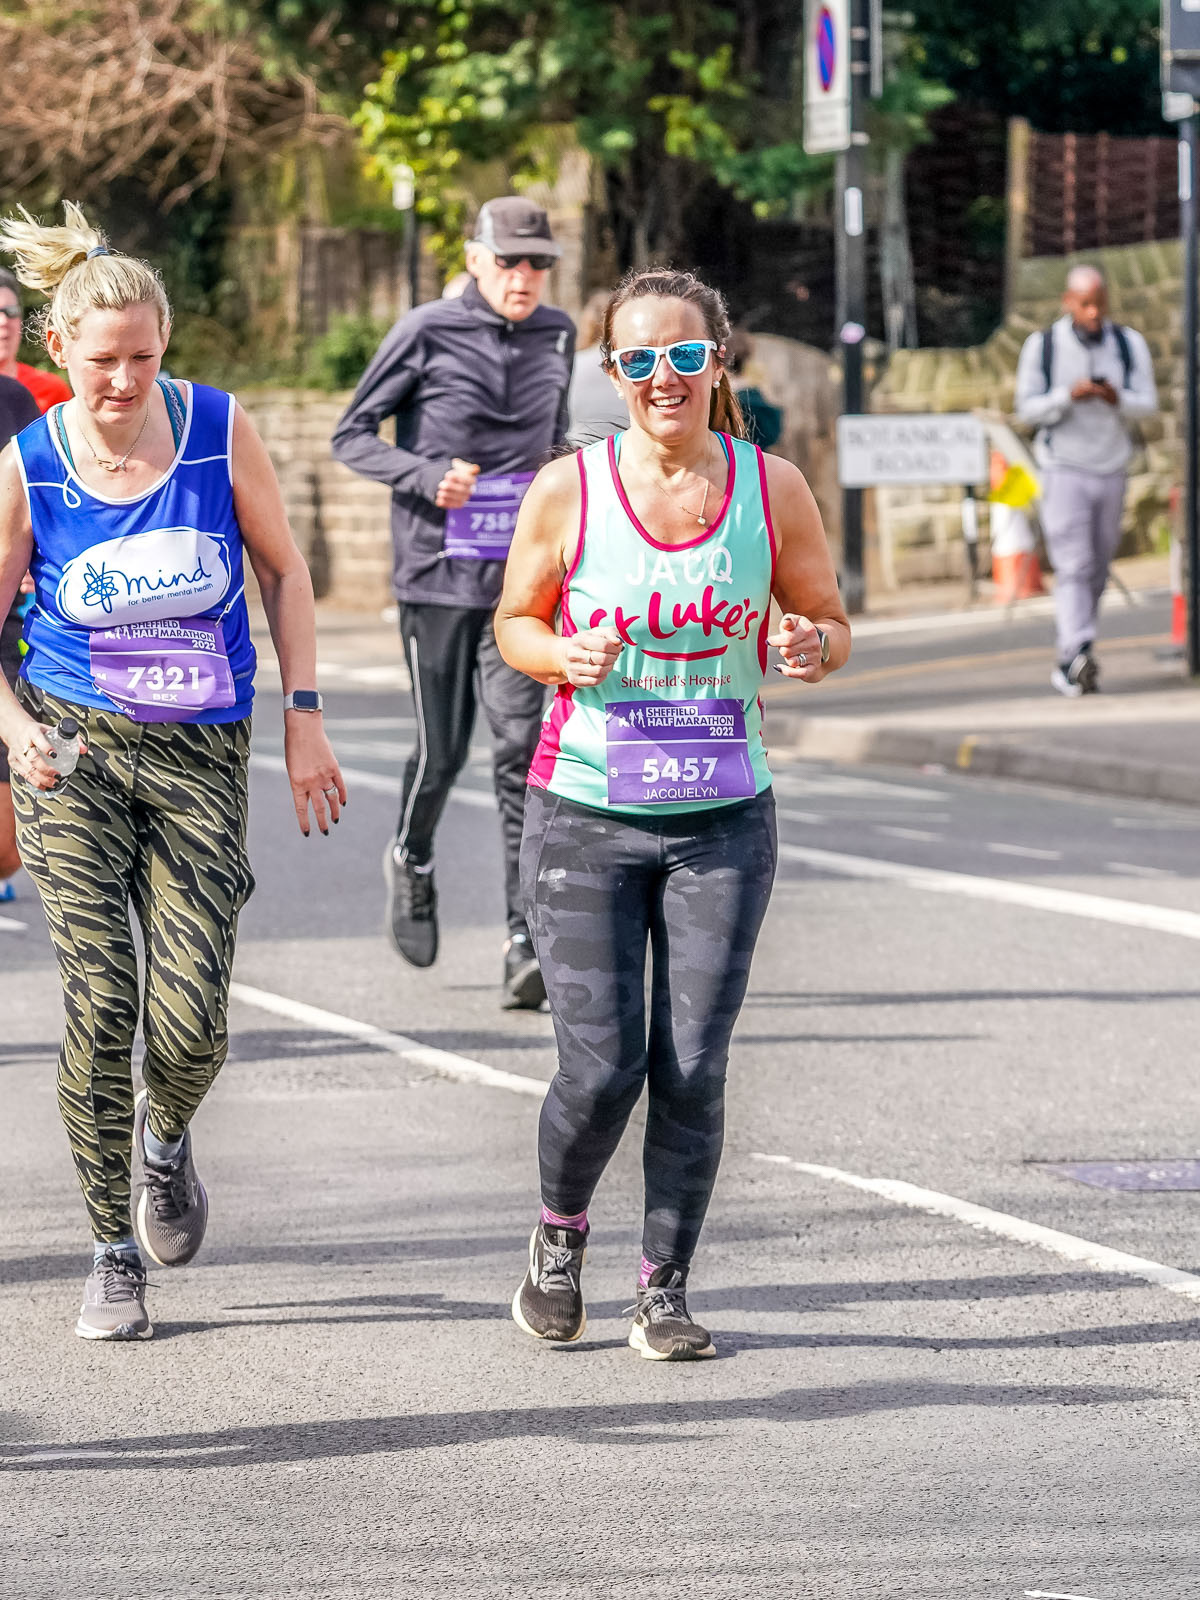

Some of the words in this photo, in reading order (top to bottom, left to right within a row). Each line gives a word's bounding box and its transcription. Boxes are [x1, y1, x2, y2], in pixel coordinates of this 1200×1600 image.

[872, 451, 950, 474] ROAD
[625, 545, 734, 586] JACQ
[121, 556, 212, 596] mind
[128, 599, 139, 607] for
[141, 593, 165, 604] better
[167, 588, 193, 599] mental
[194, 582, 214, 594] health
[648, 585, 758, 640] Luke's
[130, 620, 179, 629] SHEFFIELD
[132, 629, 158, 639] HALF
[160, 628, 215, 641] MARATHON
[192, 640, 217, 651] 2022
[126, 666, 200, 691] 7321
[621, 674, 686, 690] Sheffield's
[152, 693, 178, 702] BEX
[647, 707, 696, 717] SHEFFIELD
[647, 717, 674, 727] HALF
[675, 716, 733, 726] MARATHON
[709, 726, 734, 736] 2022
[610, 768, 618, 778] S
[641, 757, 718, 784] 5457
[643, 786, 718, 800] JACQUELYN
